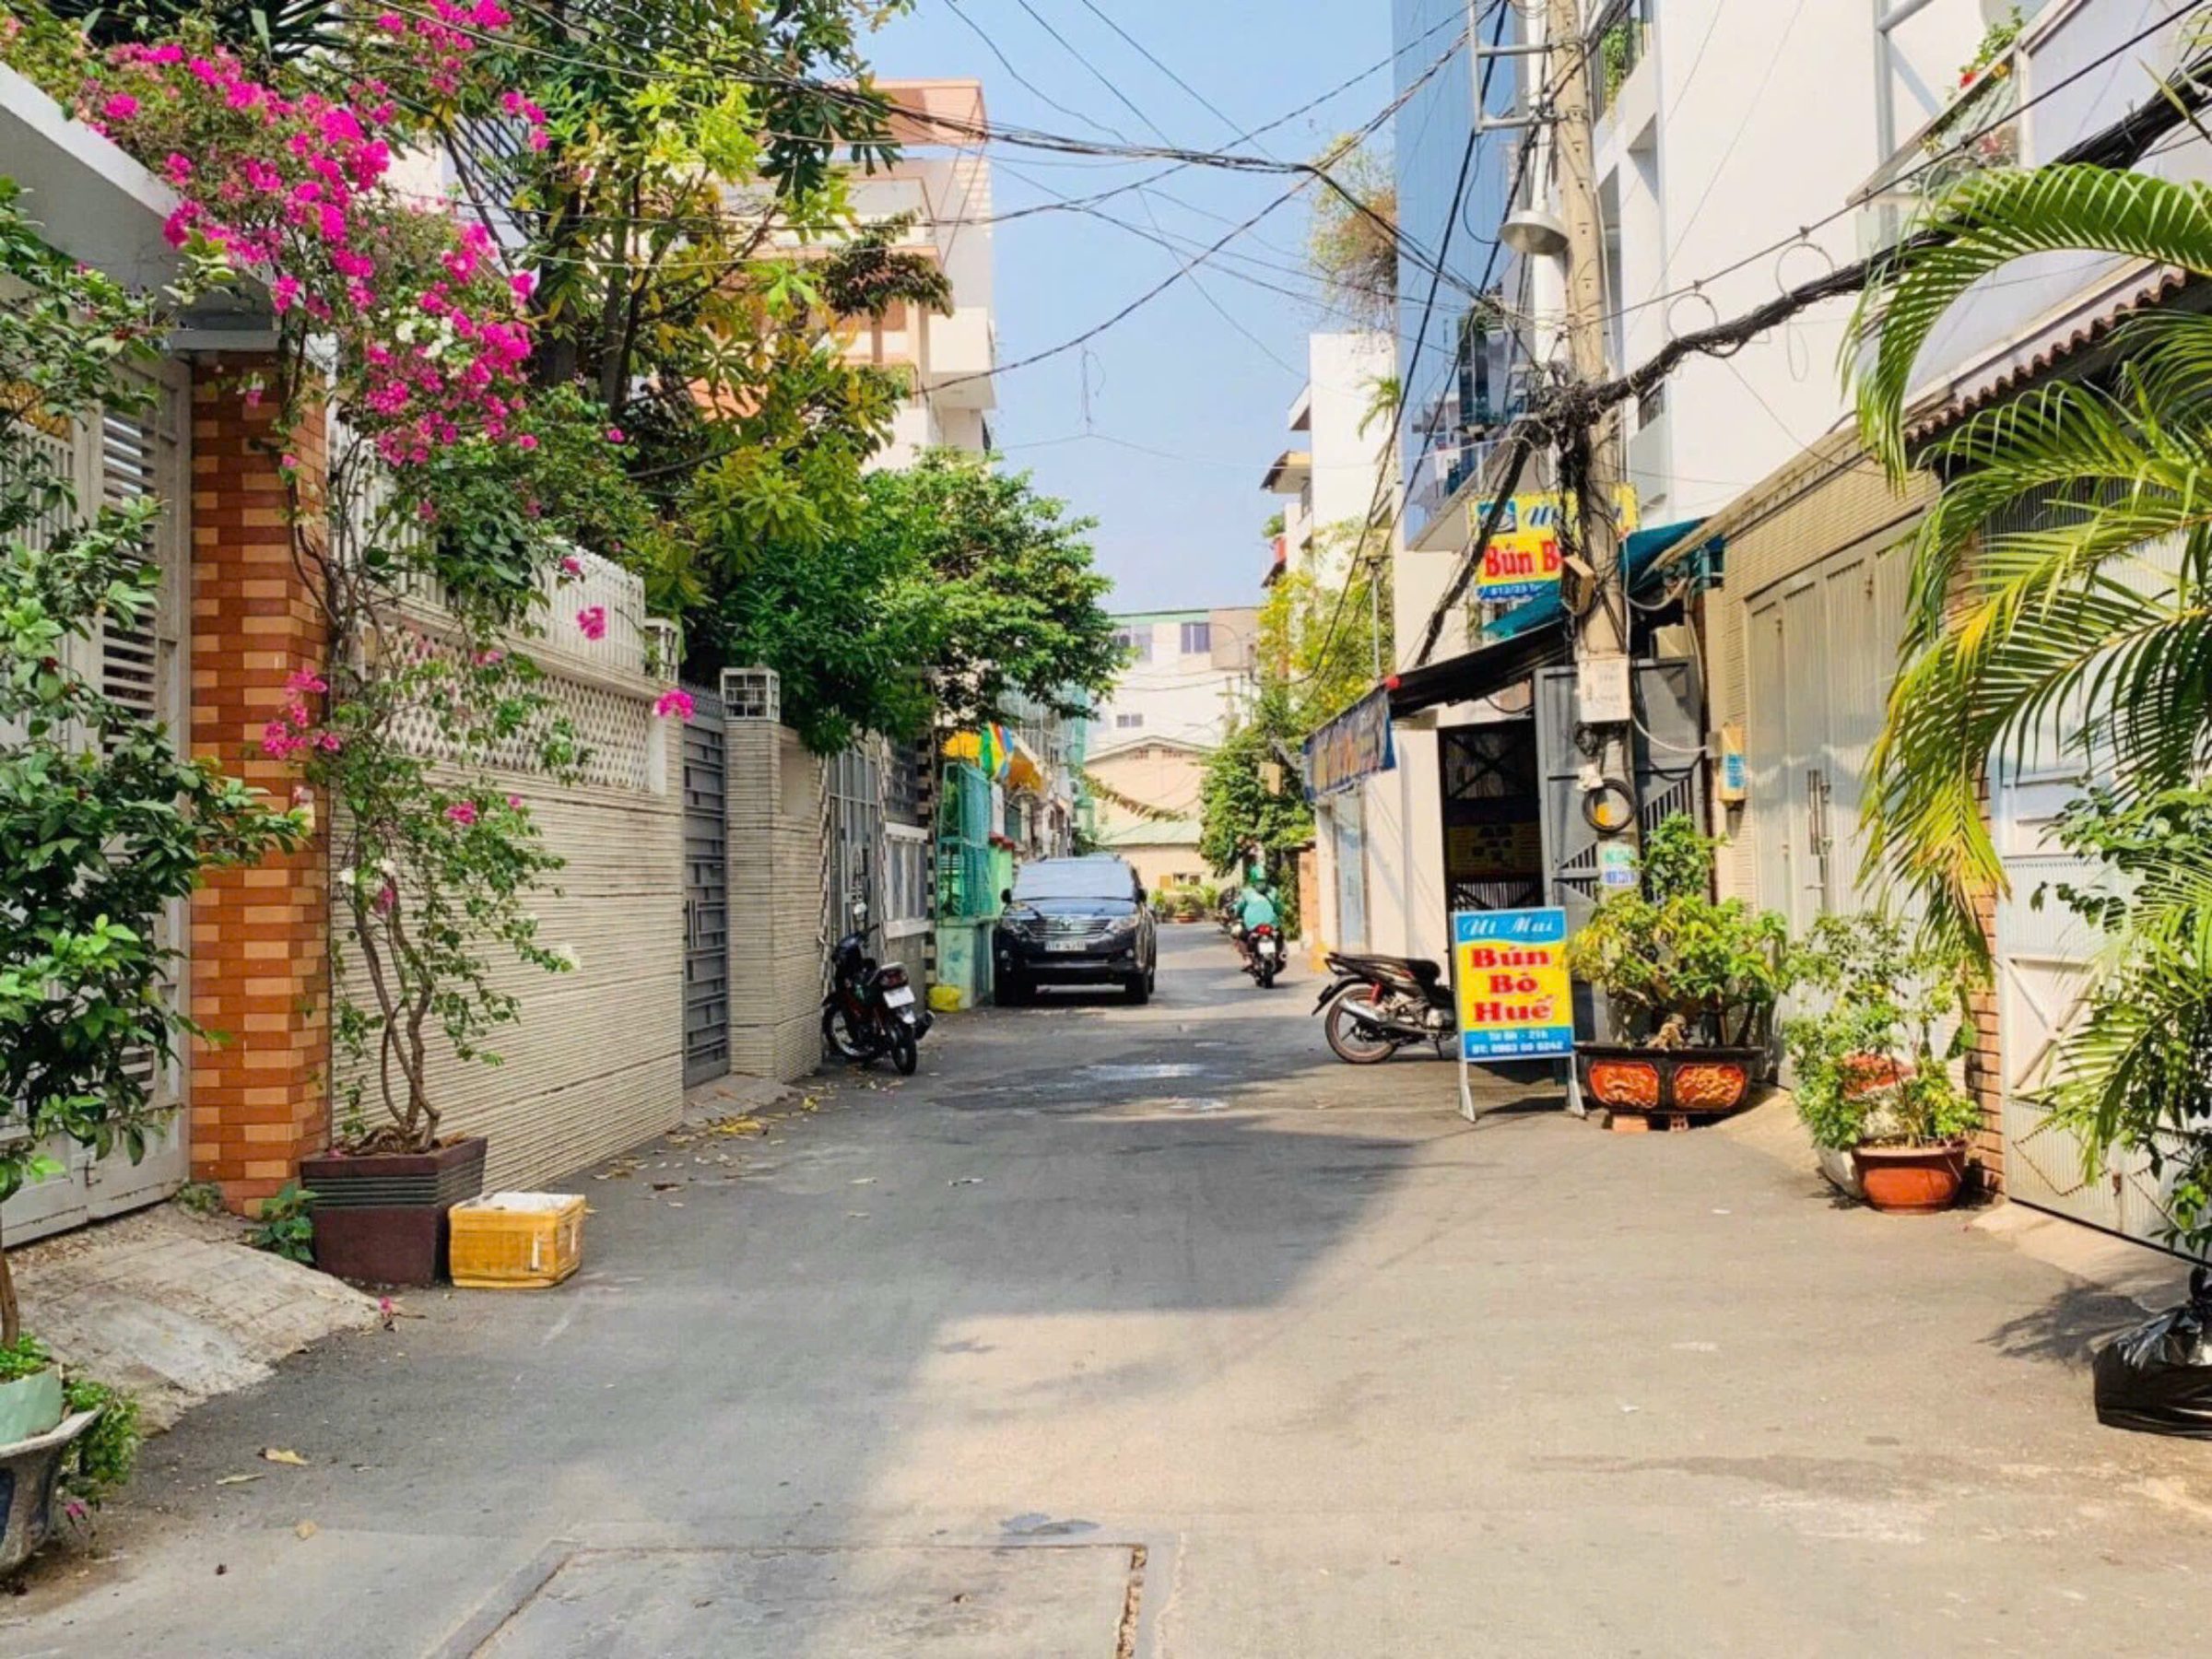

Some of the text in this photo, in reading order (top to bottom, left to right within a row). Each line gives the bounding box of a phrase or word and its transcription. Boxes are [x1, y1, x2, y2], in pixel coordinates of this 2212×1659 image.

[1485, 540, 1562, 577] Bún B
[1471, 946, 1550, 969] Bún
[1489, 971, 1538, 994] Bò
[1474, 994, 1554, 1022] Huế
